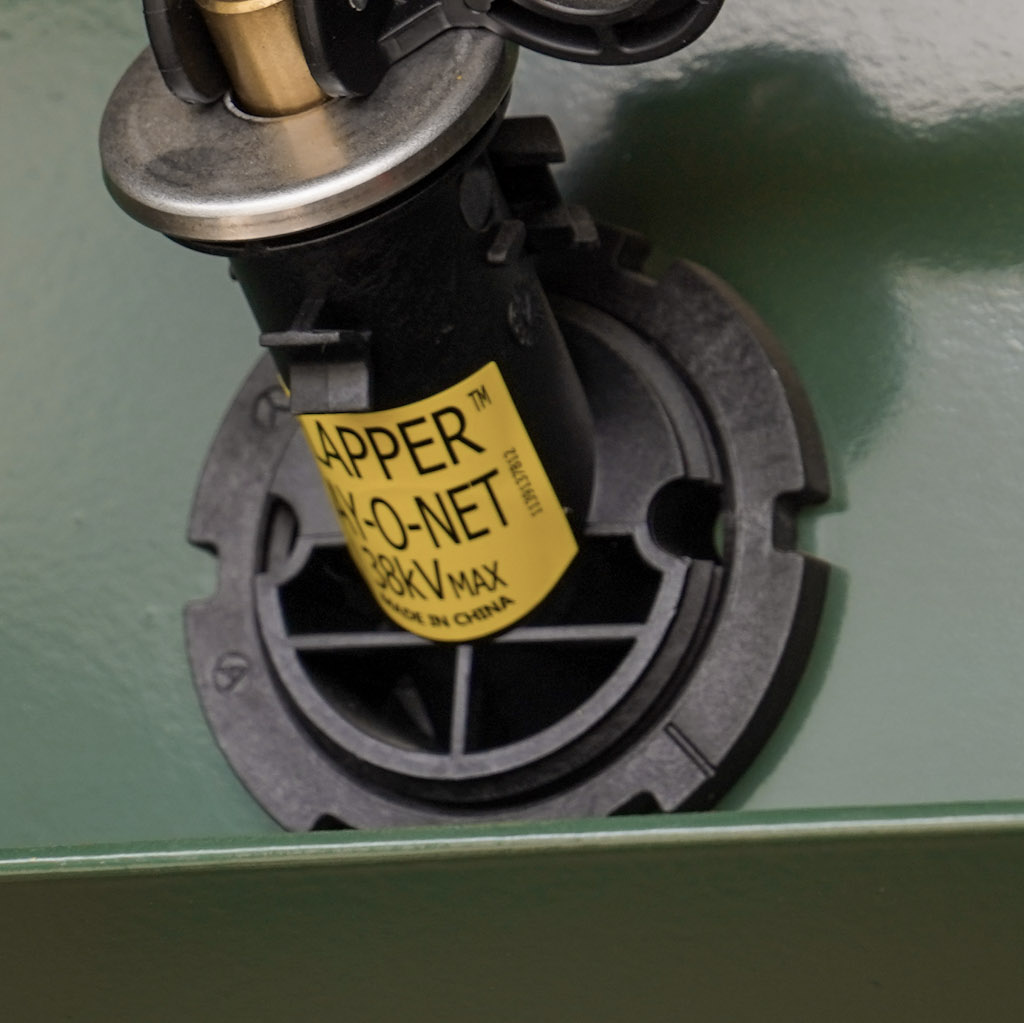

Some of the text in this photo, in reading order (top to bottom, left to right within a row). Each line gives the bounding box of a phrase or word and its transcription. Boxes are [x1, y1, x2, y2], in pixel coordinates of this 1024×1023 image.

[362, 546, 508, 600] 38kV MAX
[430, 613, 451, 628] IN
[454, 595, 517, 626] CHINA
